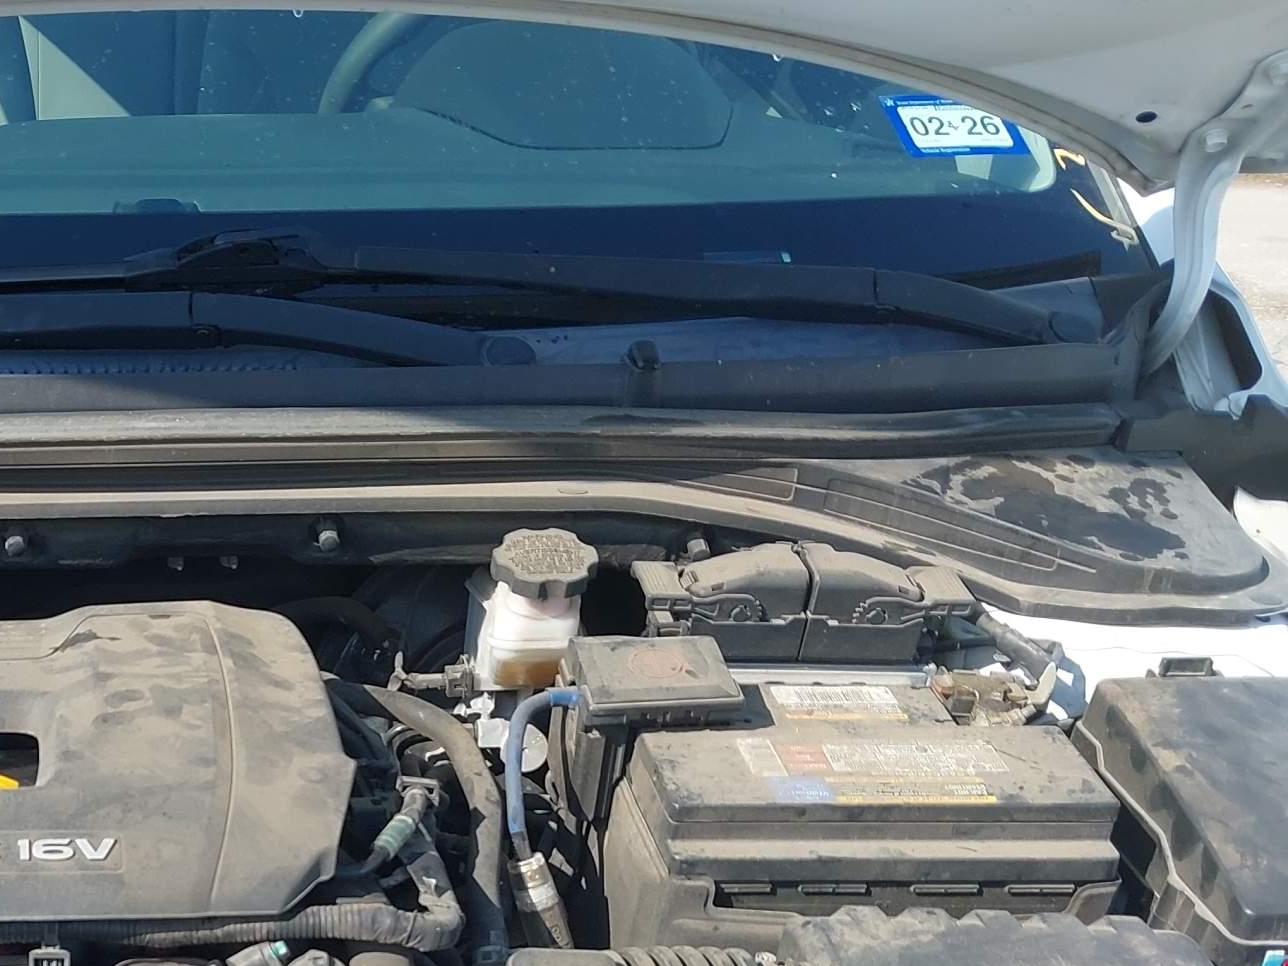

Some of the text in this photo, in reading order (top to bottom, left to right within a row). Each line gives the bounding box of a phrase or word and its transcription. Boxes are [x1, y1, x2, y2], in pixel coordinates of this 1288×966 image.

[909, 115, 1001, 136] 02 26
[17, 838, 118, 862] 16V
